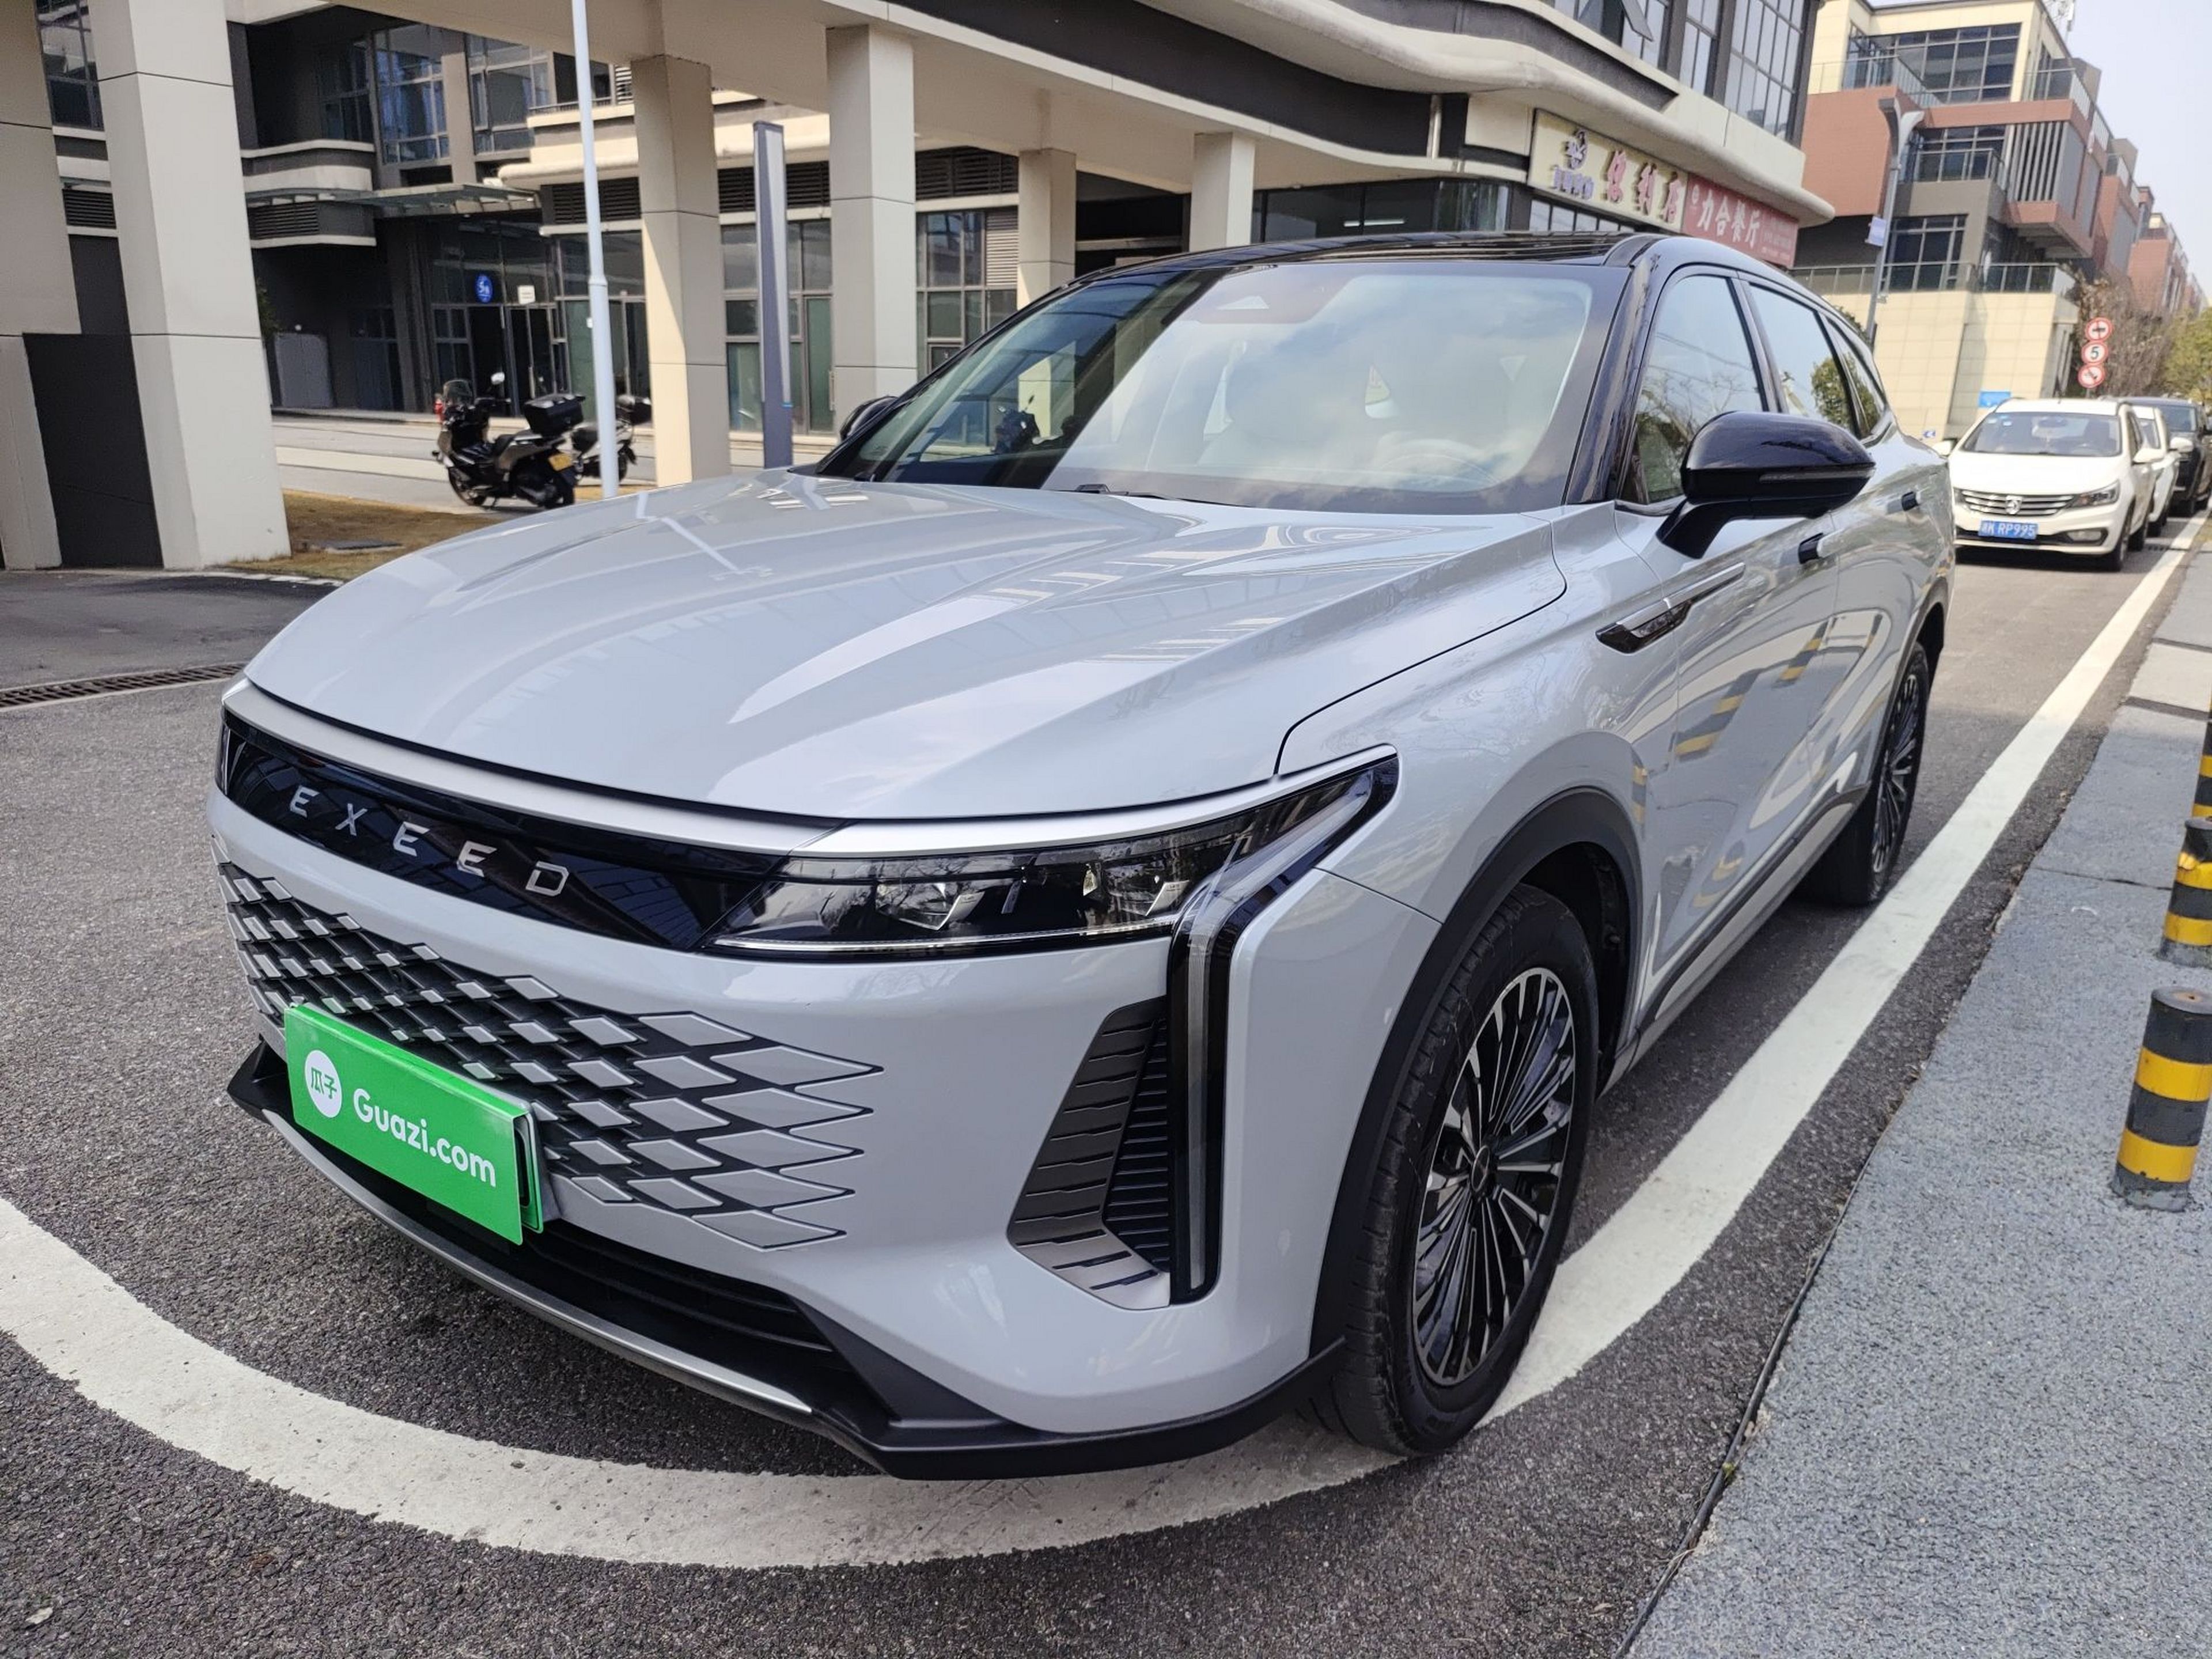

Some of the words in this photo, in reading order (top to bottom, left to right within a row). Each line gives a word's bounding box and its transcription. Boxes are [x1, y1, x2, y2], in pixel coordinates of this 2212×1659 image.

[1697, 189, 1760, 249] 力合餐厅
[2090, 346, 2099, 360] 5
[290, 785, 569, 897] EXEED
[310, 1067, 338, 1099] 瓜子
[353, 1088, 496, 1187] Guazi.com
